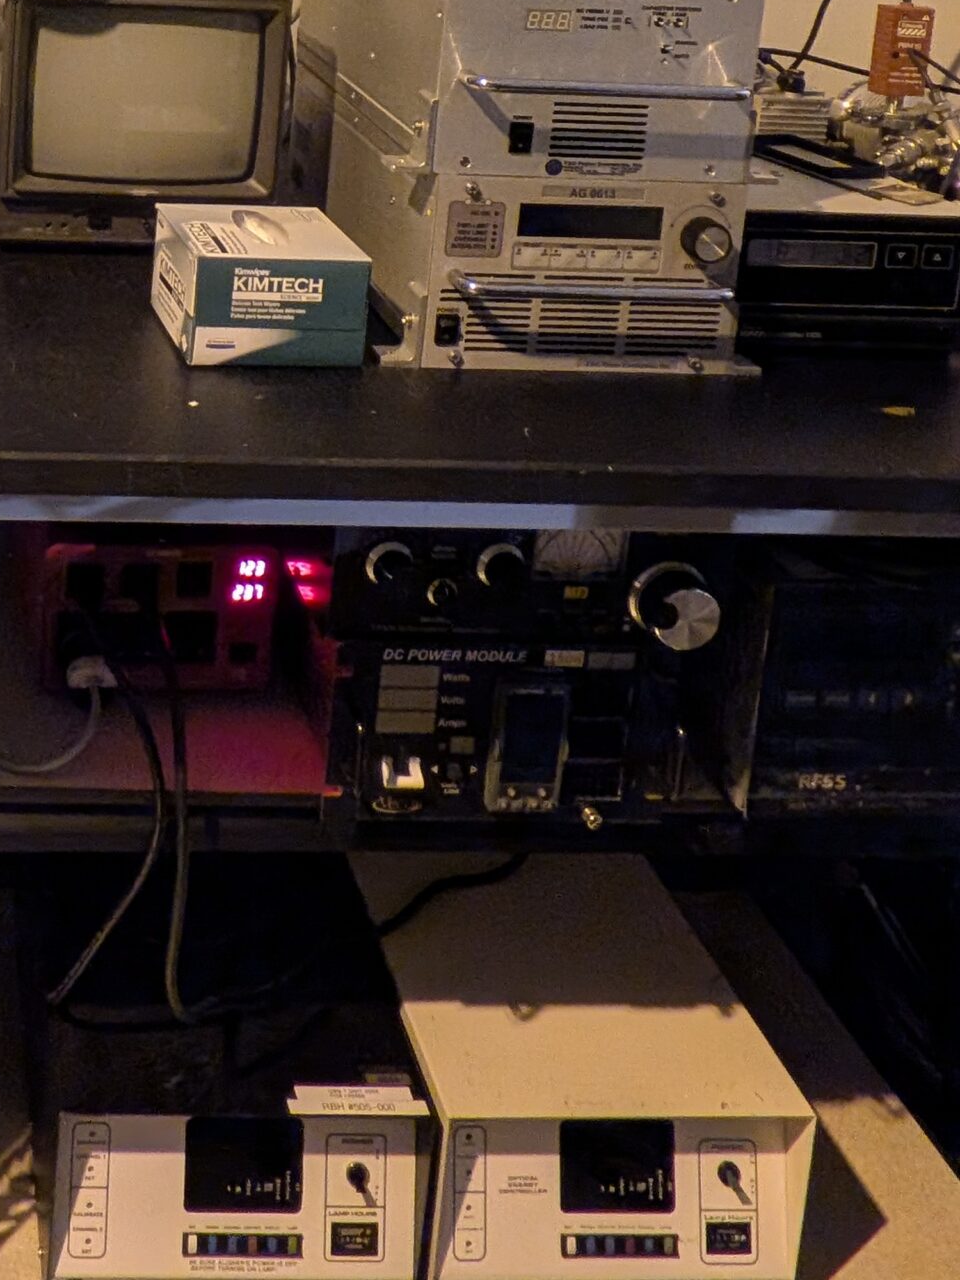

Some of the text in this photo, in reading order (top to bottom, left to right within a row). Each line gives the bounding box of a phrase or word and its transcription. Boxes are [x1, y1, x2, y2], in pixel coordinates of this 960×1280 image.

[570, 188, 587, 198] AG
[233, 276, 324, 294] KIMTECH
[383, 648, 528, 663] DC POWER MODULE
[442, 673, 470, 682] Watts
